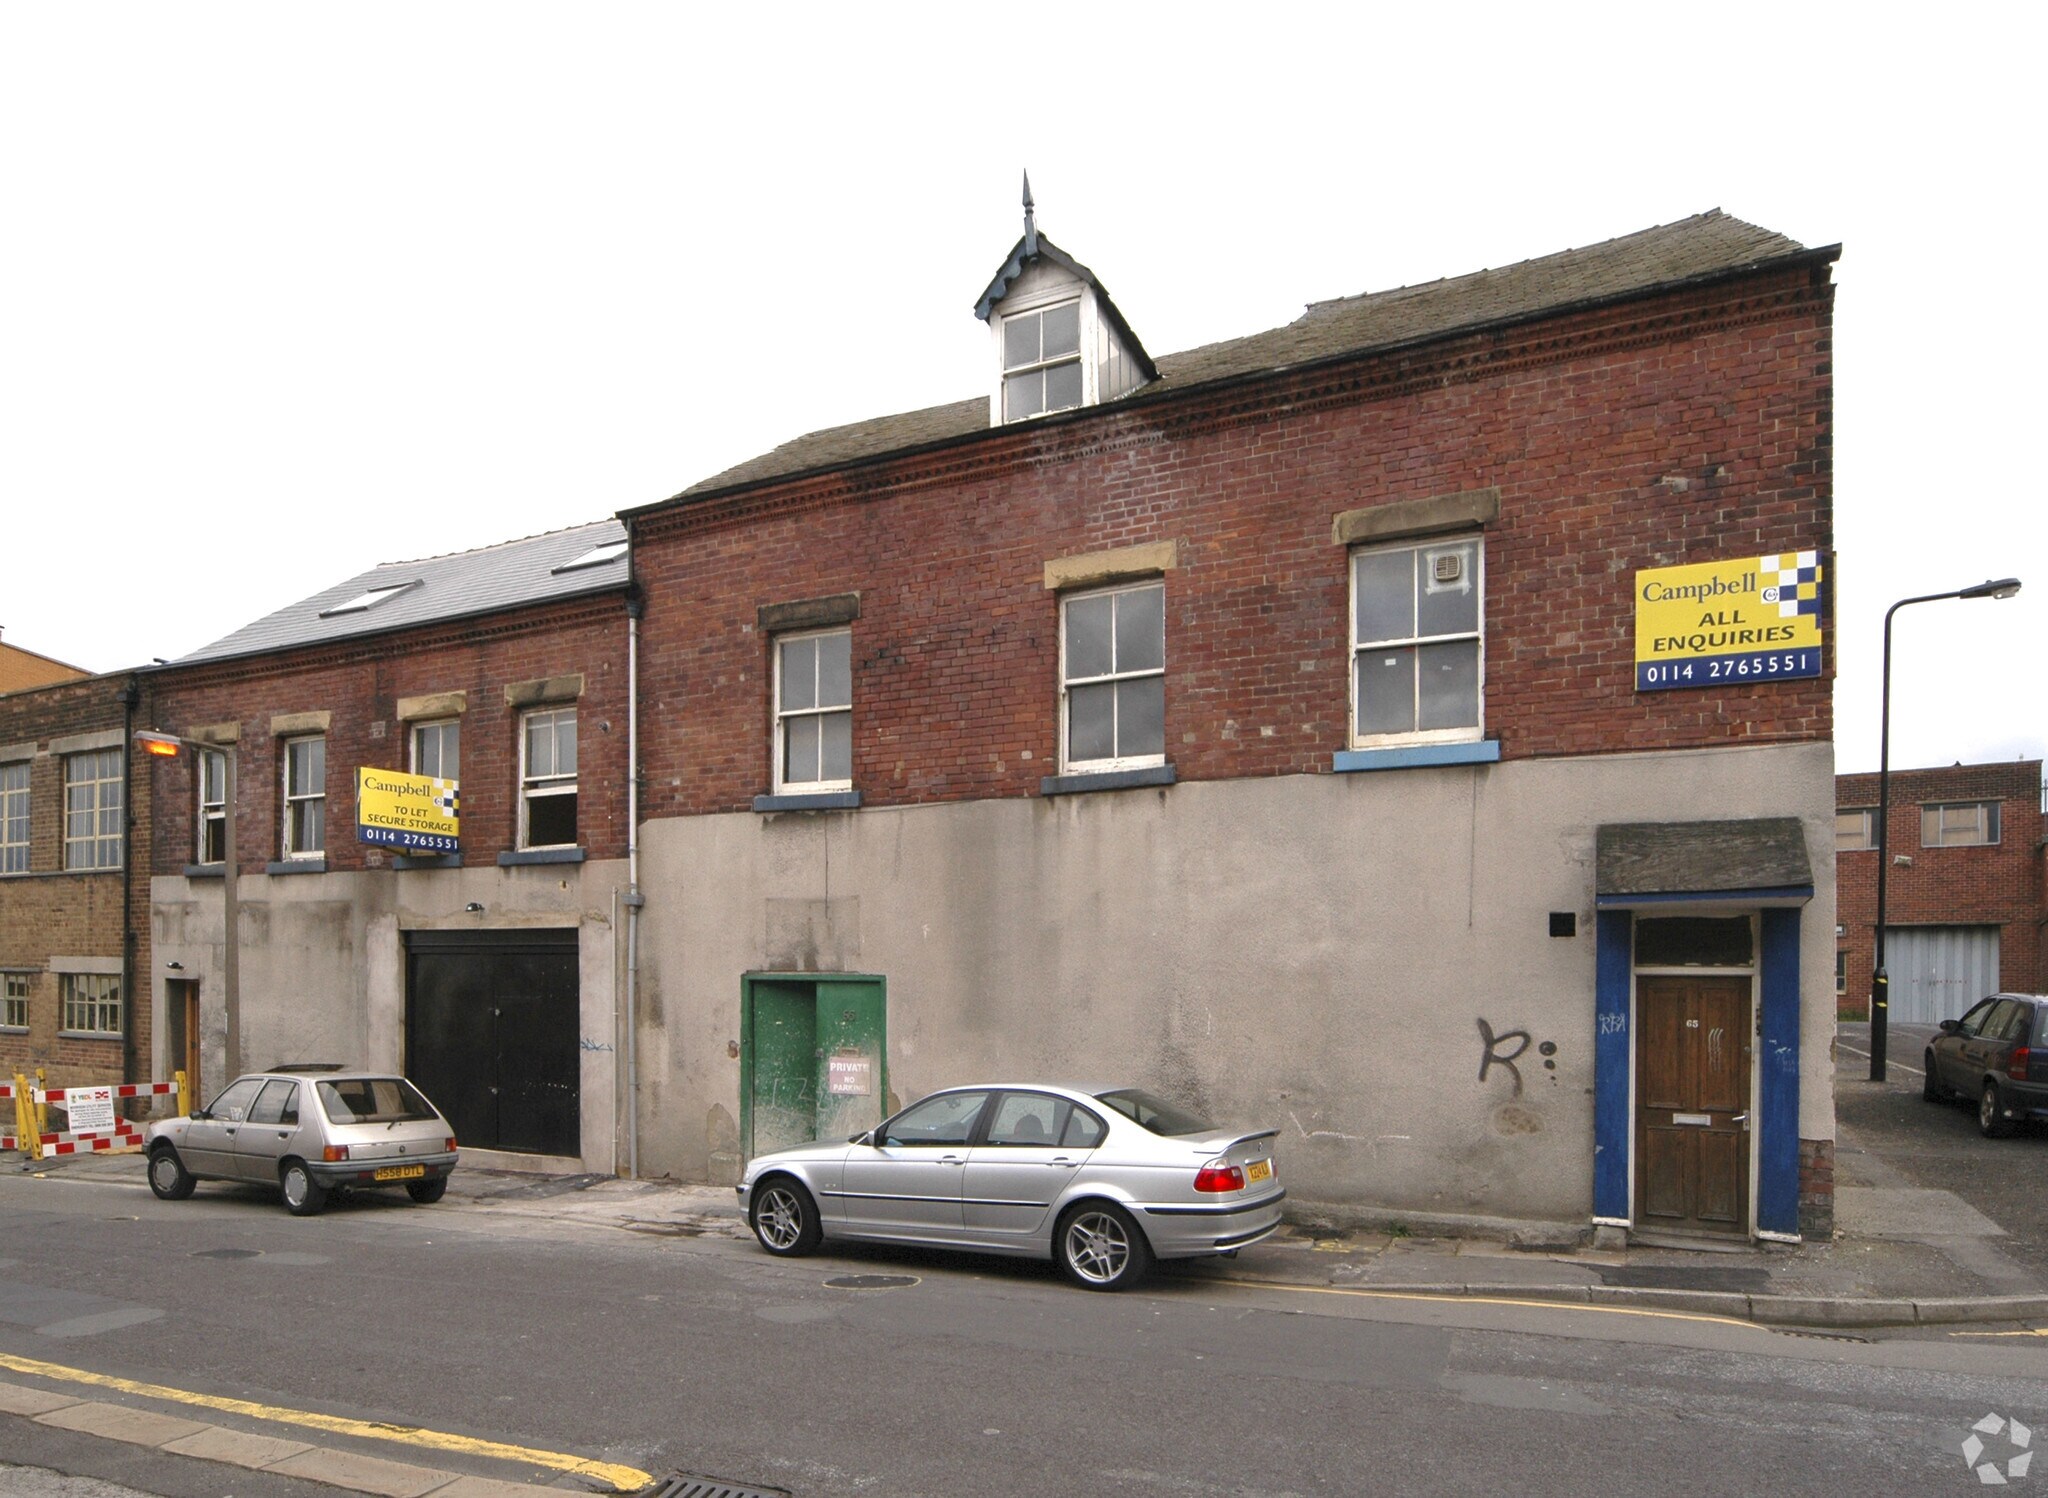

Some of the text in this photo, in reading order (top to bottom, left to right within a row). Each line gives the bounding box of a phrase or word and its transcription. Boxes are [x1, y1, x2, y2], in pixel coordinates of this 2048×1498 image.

[1642, 572, 1756, 604] Campbell
[1698, 610, 1746, 628] ALL
[1653, 625, 1795, 652] ENQUIRIES
[1647, 654, 1806, 683] 0114 2765551
[364, 776, 430, 798] Campbell
[394, 805, 428, 817] TO LET
[367, 813, 453, 832] SECURE STORAGE
[366, 829, 457, 850] 0114 2765551
[1686, 1019, 1699, 1028] 65
[830, 1062, 869, 1072] PRIVATE
[833, 1084, 866, 1092] PARKING
